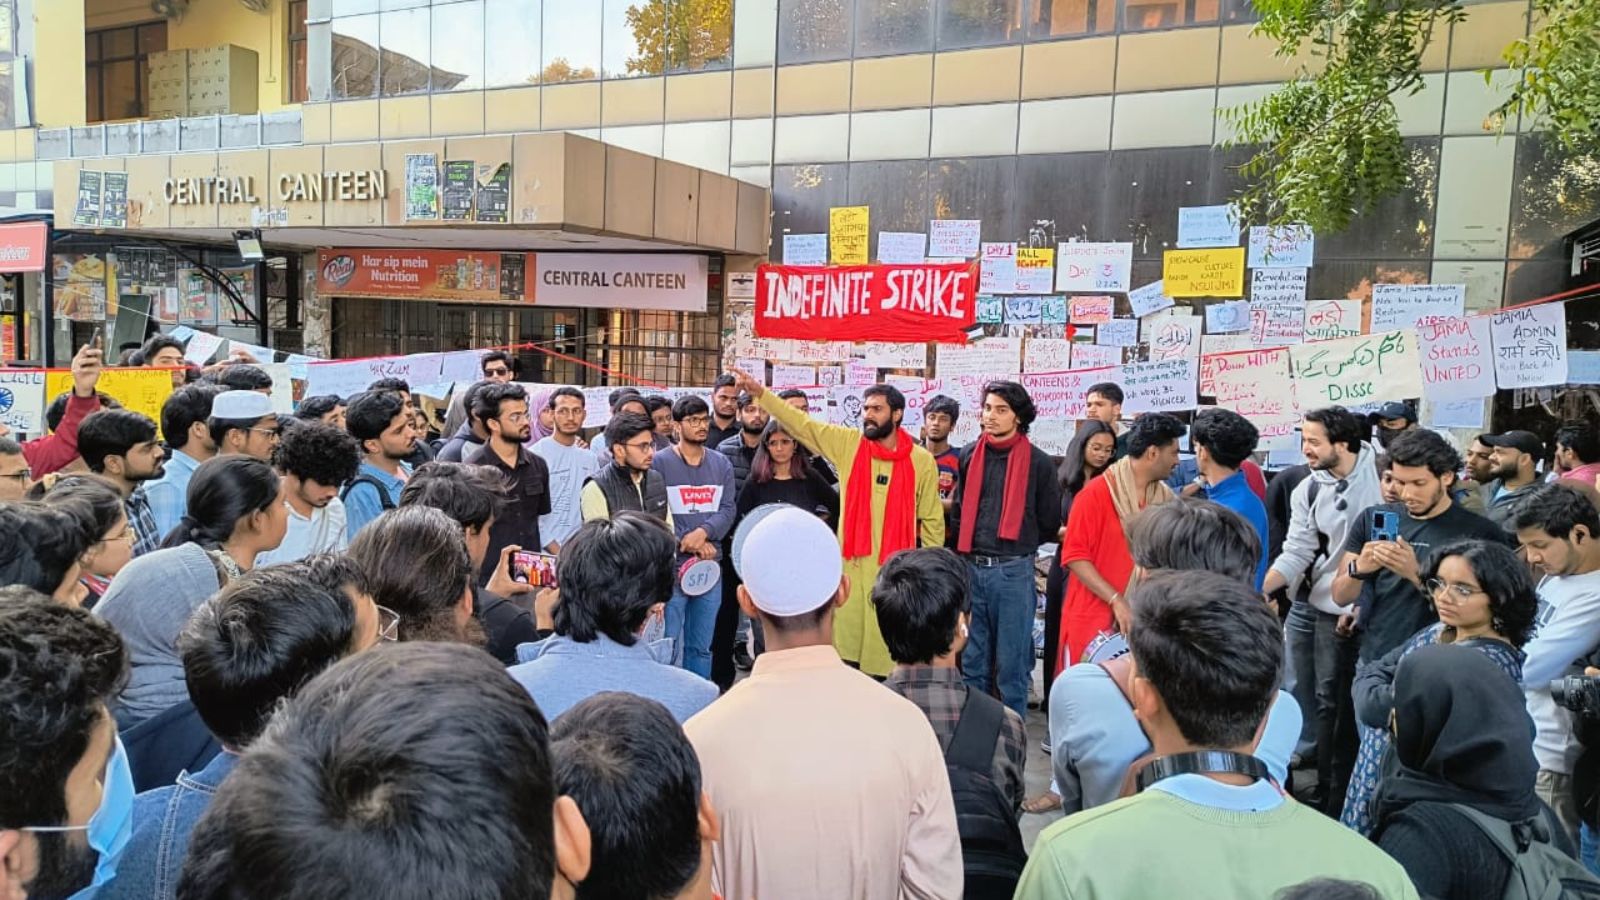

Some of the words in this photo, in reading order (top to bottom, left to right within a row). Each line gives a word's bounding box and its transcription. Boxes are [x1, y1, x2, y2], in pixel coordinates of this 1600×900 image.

[163, 176, 258, 205] CENTRAL
[279, 170, 388, 202] CANTEEN
[362, 255, 382, 267] Har
[383, 255, 401, 272] sip
[402, 256, 428, 269] mein
[371, 269, 418, 282] Nutrition
[543, 270, 610, 288] CENTRAL
[614, 271, 686, 290] CANTEEN
[763, 272, 873, 319] INDEFINITE
[881, 269, 970, 319] STRIKE
[1494, 308, 1537, 325] JAMIA
[1424, 321, 1476, 341] JAMIA
[1513, 324, 1557, 340] ADMIN
[1248, 350, 1279, 366] WITH
[1428, 342, 1481, 361] Stands
[1023, 375, 1071, 388] CANTEENS
[1425, 363, 1482, 383] UNITED
